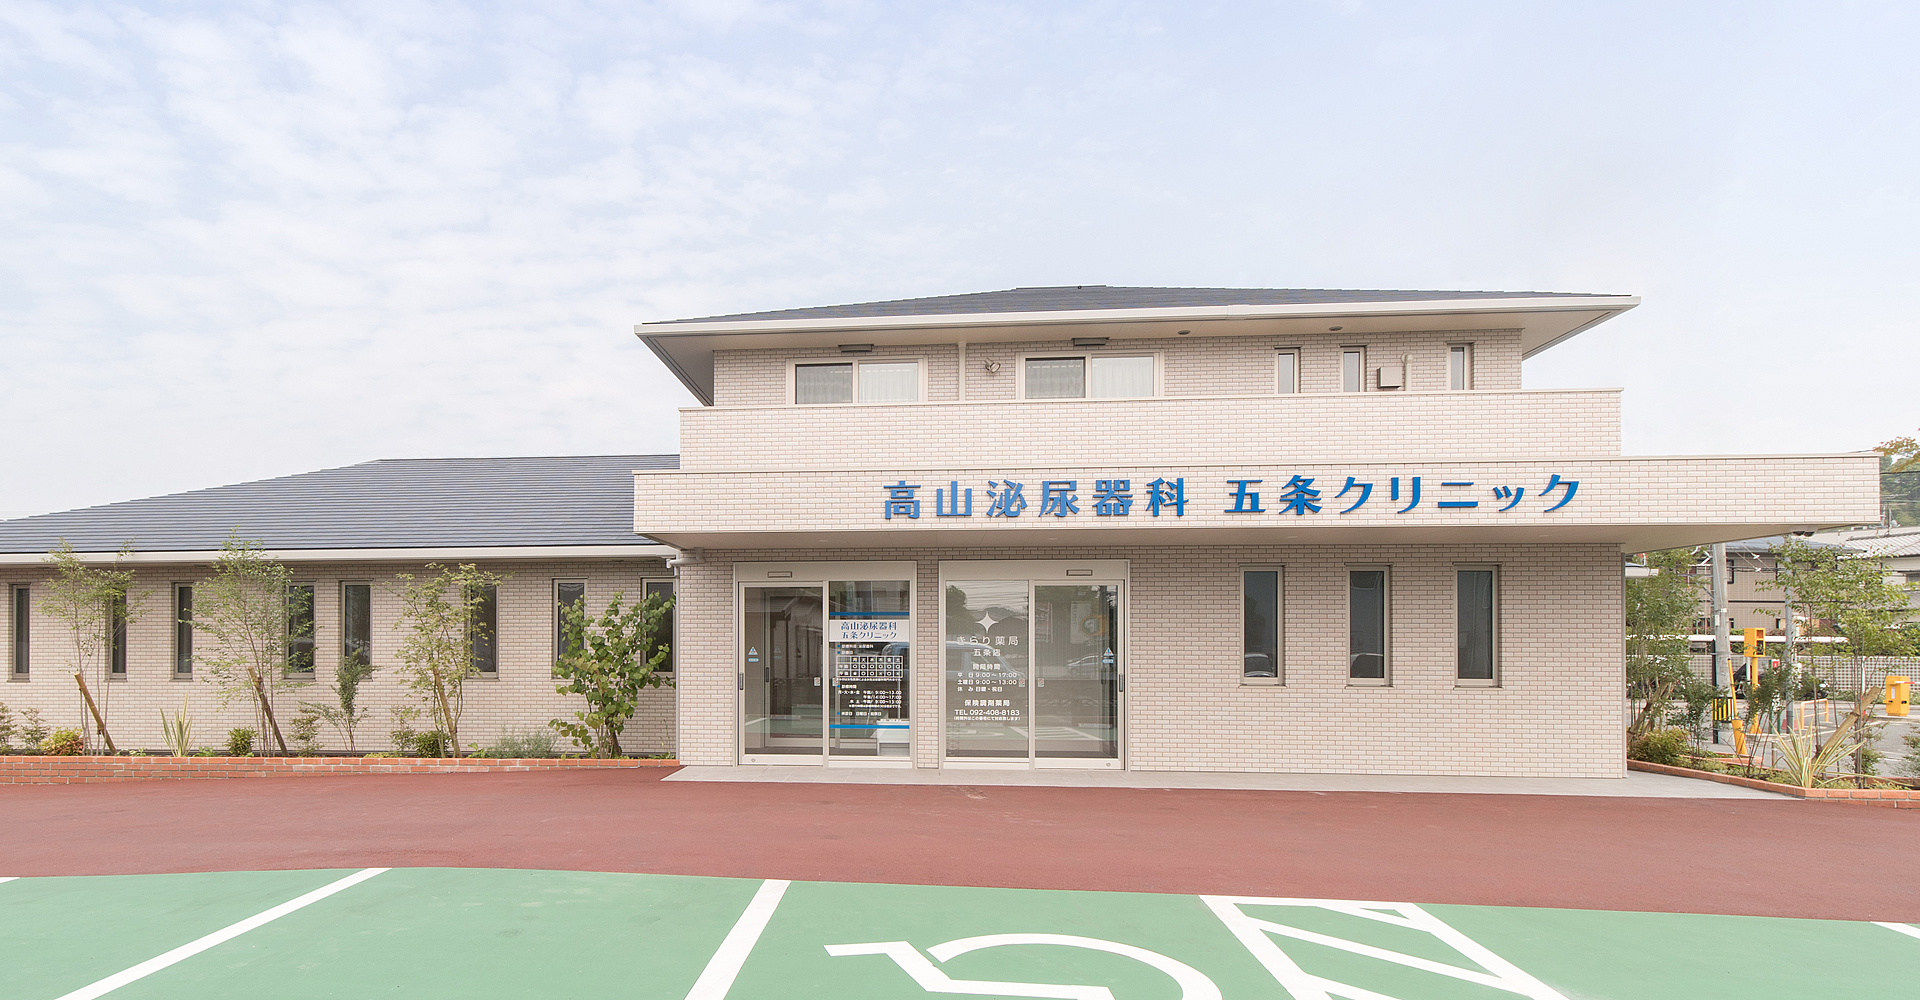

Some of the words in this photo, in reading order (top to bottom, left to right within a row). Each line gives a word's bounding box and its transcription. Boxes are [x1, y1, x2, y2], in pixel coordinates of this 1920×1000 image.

[884, 478, 1189, 518] 高山泌尿器科
[1225, 475, 1579, 514] 五条クリニック
[841, 621, 897, 631] 高山泌尿器科
[841, 631, 897, 639] 五条クリニック
[956, 636, 1019, 646] きらり薬局
[973, 648, 1001, 657] 五条店
[964, 699, 1010, 707] 保険調剤薬局
